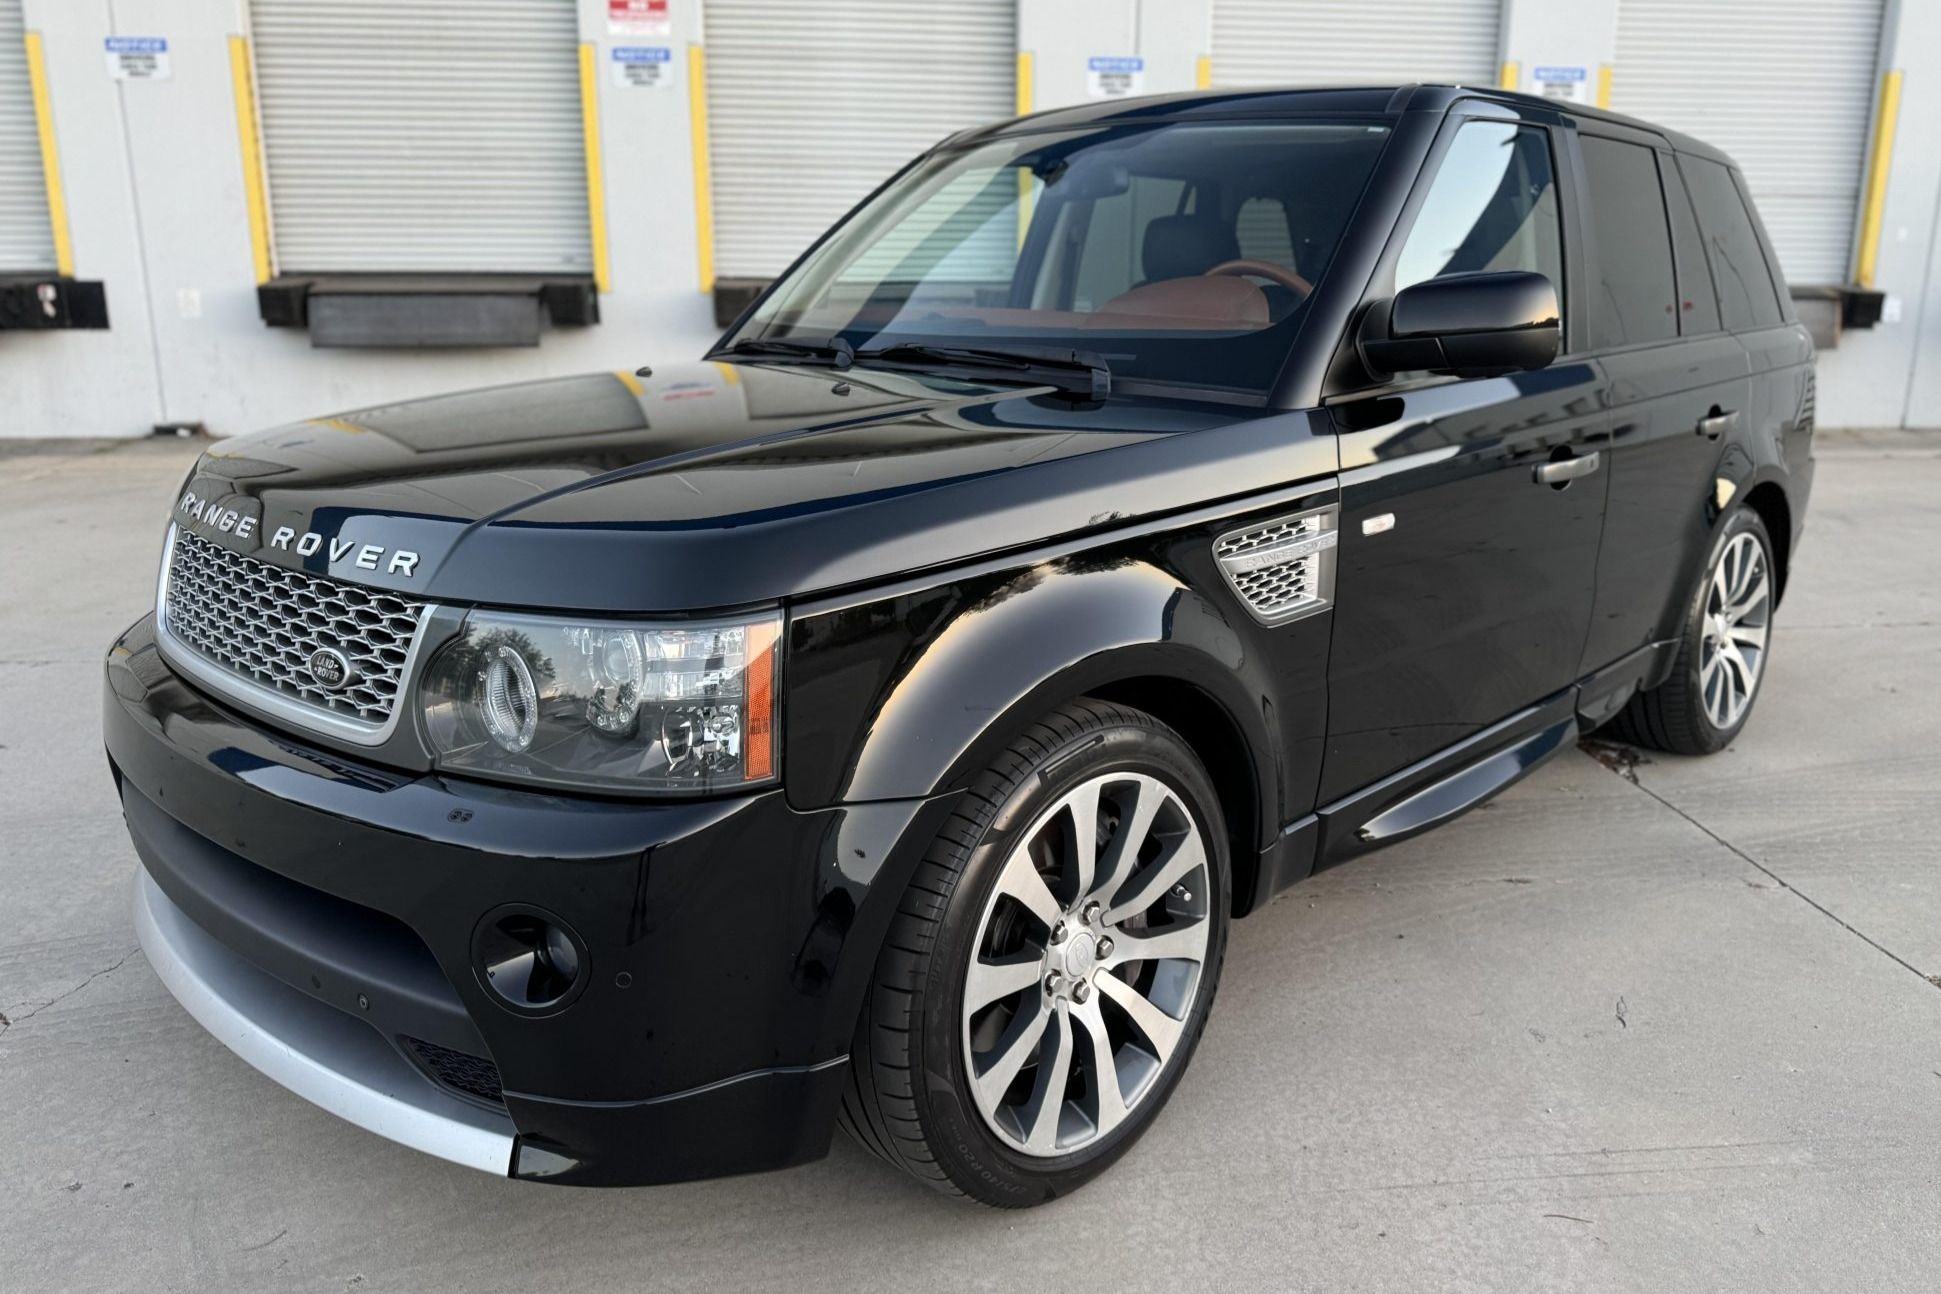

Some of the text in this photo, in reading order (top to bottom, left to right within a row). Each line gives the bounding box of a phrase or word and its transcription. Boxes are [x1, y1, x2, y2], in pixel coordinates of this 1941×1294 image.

[181, 491, 420, 577] RANGE ROVER
[316, 655, 335, 669] LAND
[316, 666, 340, 682] ROVER
